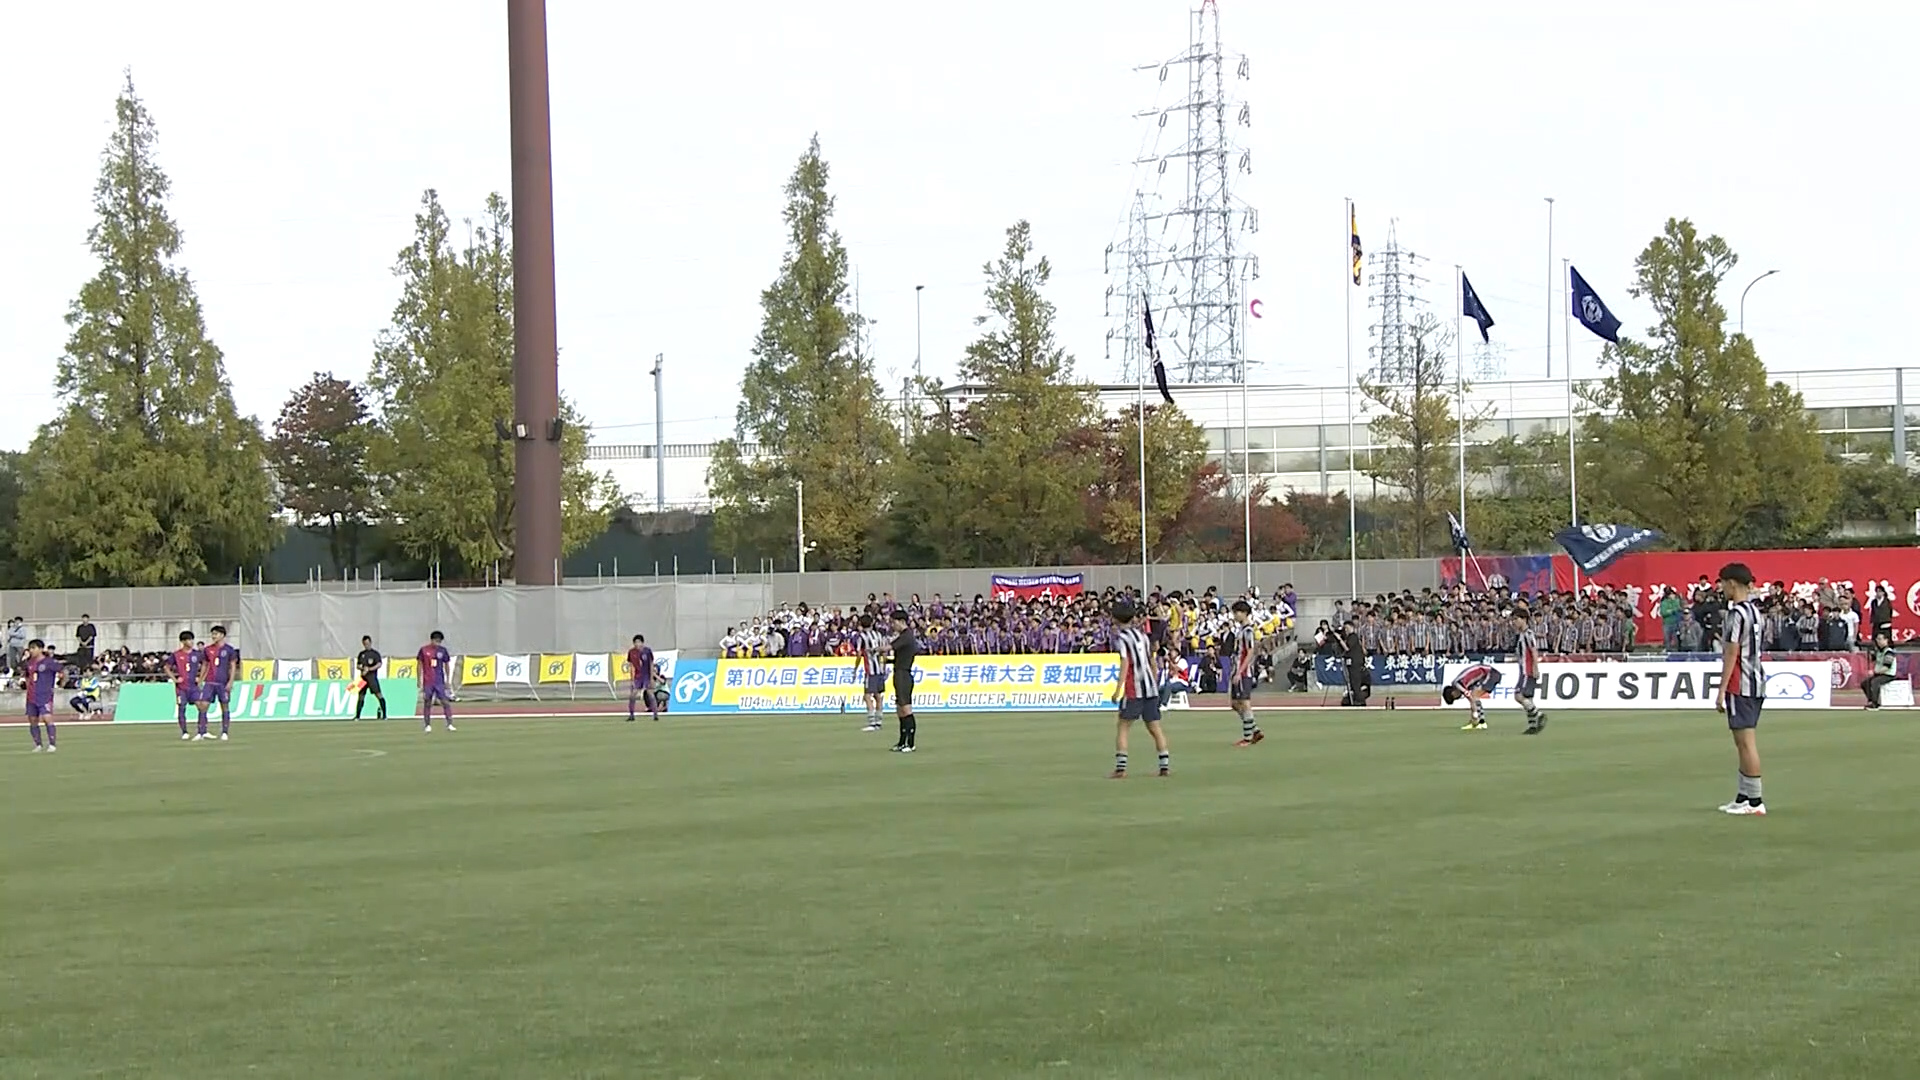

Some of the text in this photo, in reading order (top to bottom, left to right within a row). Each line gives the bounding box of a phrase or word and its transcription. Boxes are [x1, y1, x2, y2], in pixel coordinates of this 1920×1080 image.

[726, 668, 798, 687] 第104回
[775, 696, 799, 707] ALL
[805, 695, 847, 706] JAPAN
[890, 694, 943, 705] SHOOL
[950, 693, 1005, 705] SOCCER
[1012, 693, 1103, 704] TOURNAMENT
